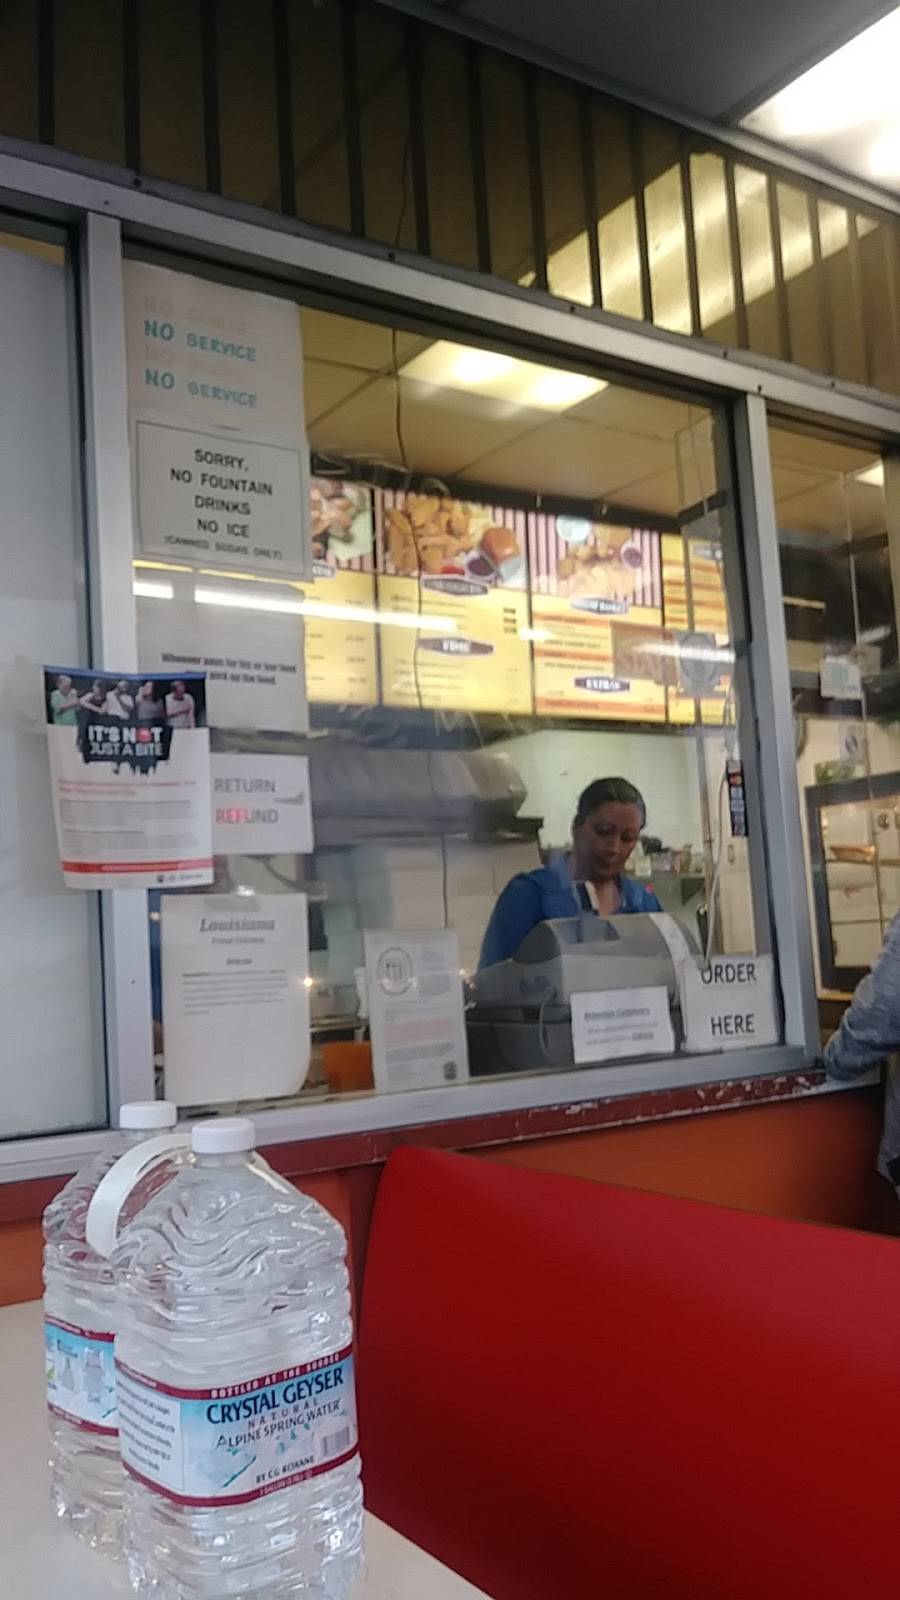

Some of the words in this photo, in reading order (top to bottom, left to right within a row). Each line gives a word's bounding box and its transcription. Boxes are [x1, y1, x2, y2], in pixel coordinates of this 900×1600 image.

[144, 320, 175, 341] NO
[186, 332, 256, 363] SERVICE
[144, 369, 175, 390] NO
[187, 381, 257, 409] SERVICE
[195, 449, 248, 471] SORRY,
[170, 468, 192, 483] NO
[201, 473, 272, 495] FOUNTAIN
[195, 495, 250, 515] DRINKS
[197, 518, 219, 534] NO
[226, 523, 250, 538] ICE
[88, 725, 120, 742] IT'S
[89, 742, 121, 755] JUST
[122, 743, 134, 755] A
[135, 742, 164, 757] BITE
[214, 778, 276, 793] RETURN
[215, 808, 279, 824] REFUND
[199, 918, 276, 933] Louisiana
[701, 962, 757, 985] ORDER
[711, 1014, 756, 1036] HERE
[210, 1380, 259, 1399] BOTTLED
[264, 1373, 277, 1386] AT
[283, 1365, 301, 1380] THE
[207, 1389, 280, 1425] CRYSTAL
[282, 1367, 344, 1403] GEYSER
[248, 1397, 320, 1428] NATURAL
[216, 1431, 261, 1450] ALPINE
[264, 1414, 305, 1437] SPRING
[306, 1399, 342, 1421] WATER
[256, 1474, 266, 1484] BY
[268, 1468, 280, 1479] CG
